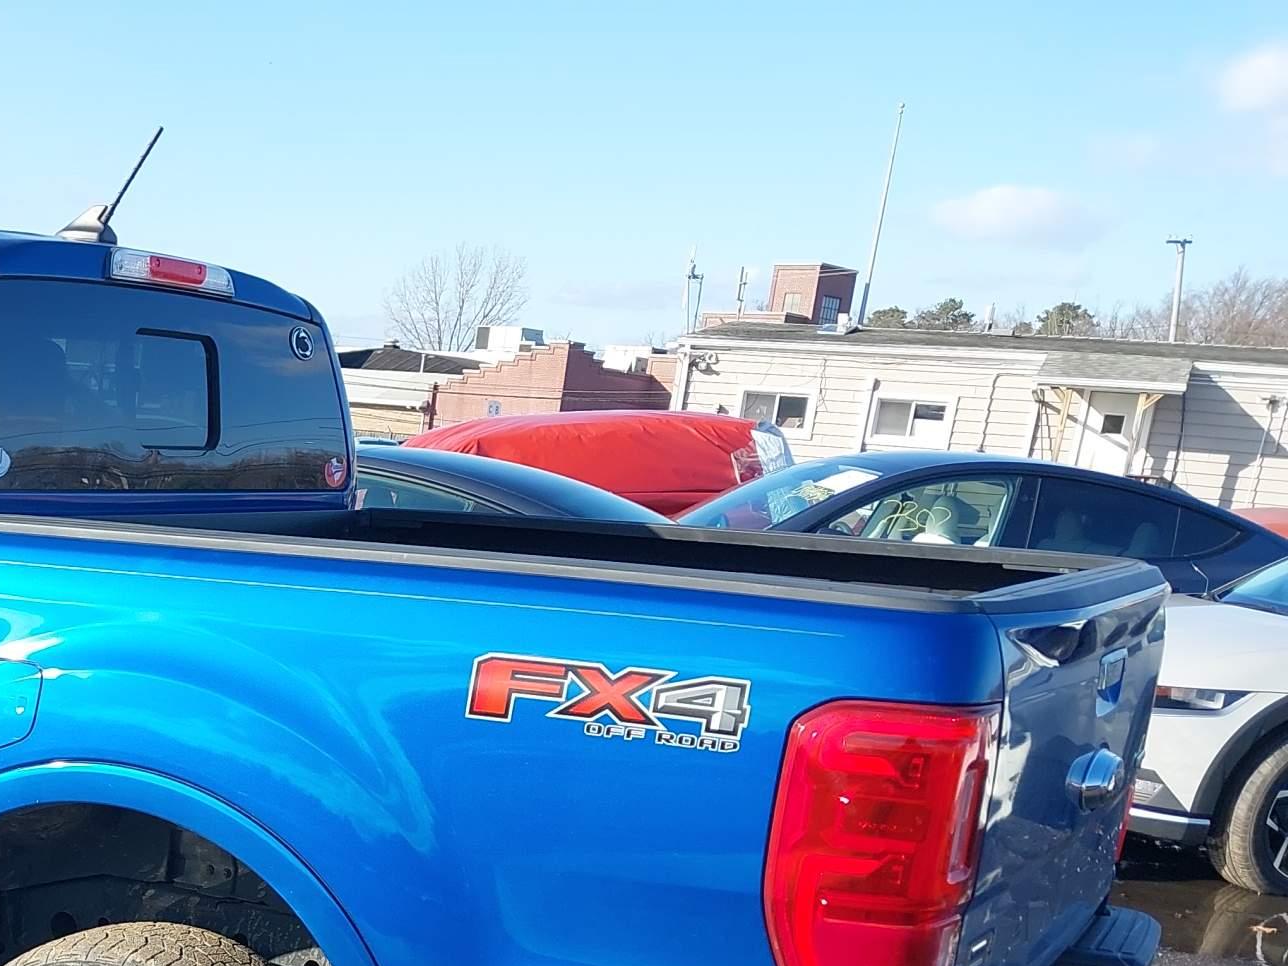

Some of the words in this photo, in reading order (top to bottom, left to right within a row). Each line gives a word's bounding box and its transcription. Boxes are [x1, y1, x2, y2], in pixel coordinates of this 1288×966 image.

[465, 652, 752, 738] FX4
[583, 722, 646, 740] OFF
[655, 730, 741, 753] ROAD
